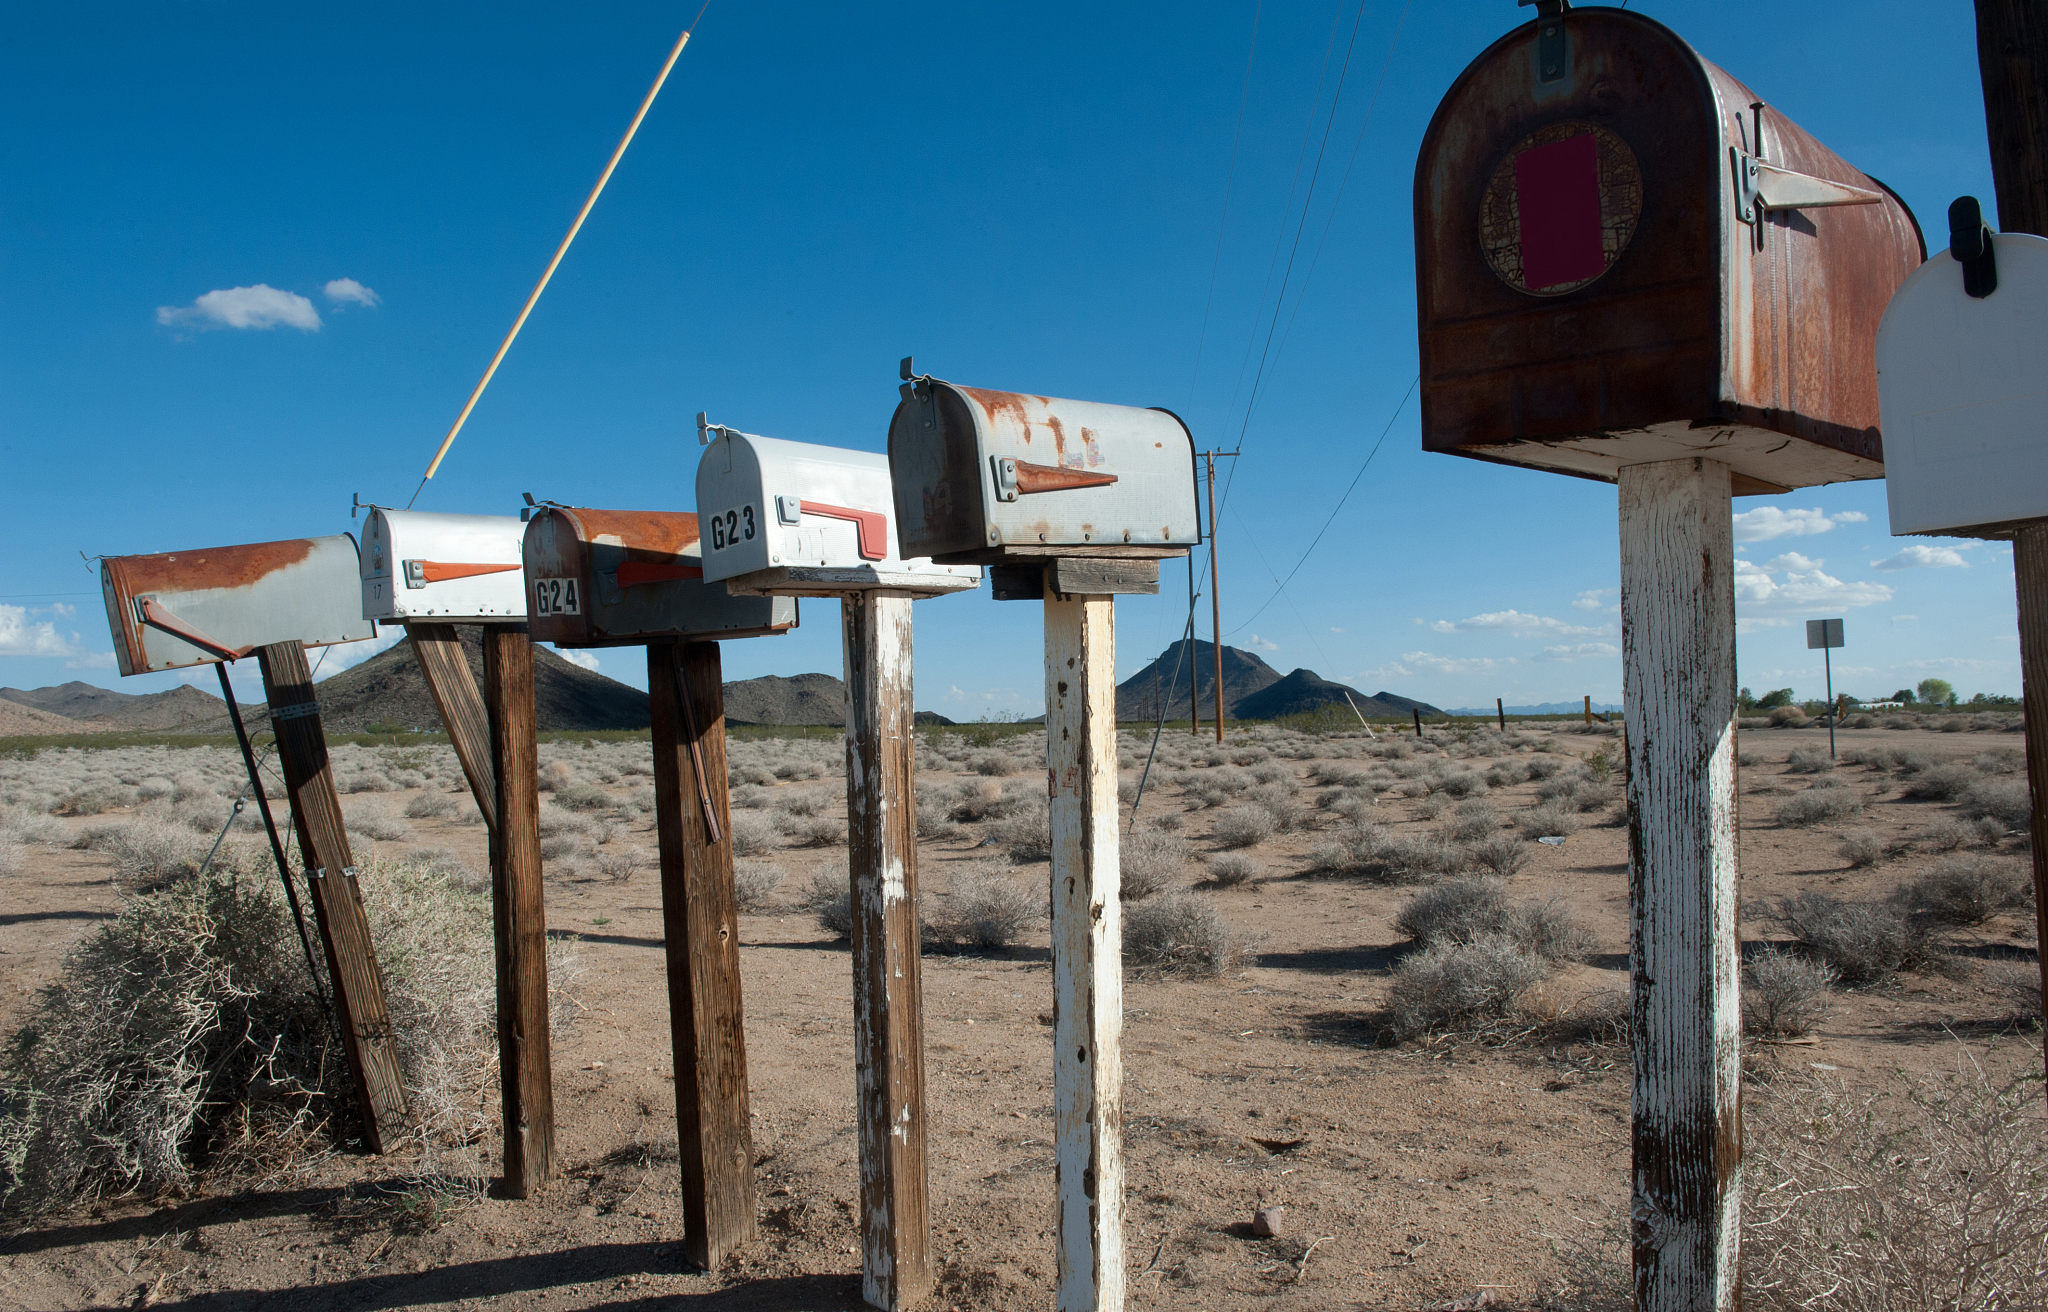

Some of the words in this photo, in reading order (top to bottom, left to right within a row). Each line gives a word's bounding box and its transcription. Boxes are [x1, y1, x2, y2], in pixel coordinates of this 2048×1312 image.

[711, 505, 756, 550] G23
[373, 584, 382, 600] 17
[537, 580, 576, 613] G24
